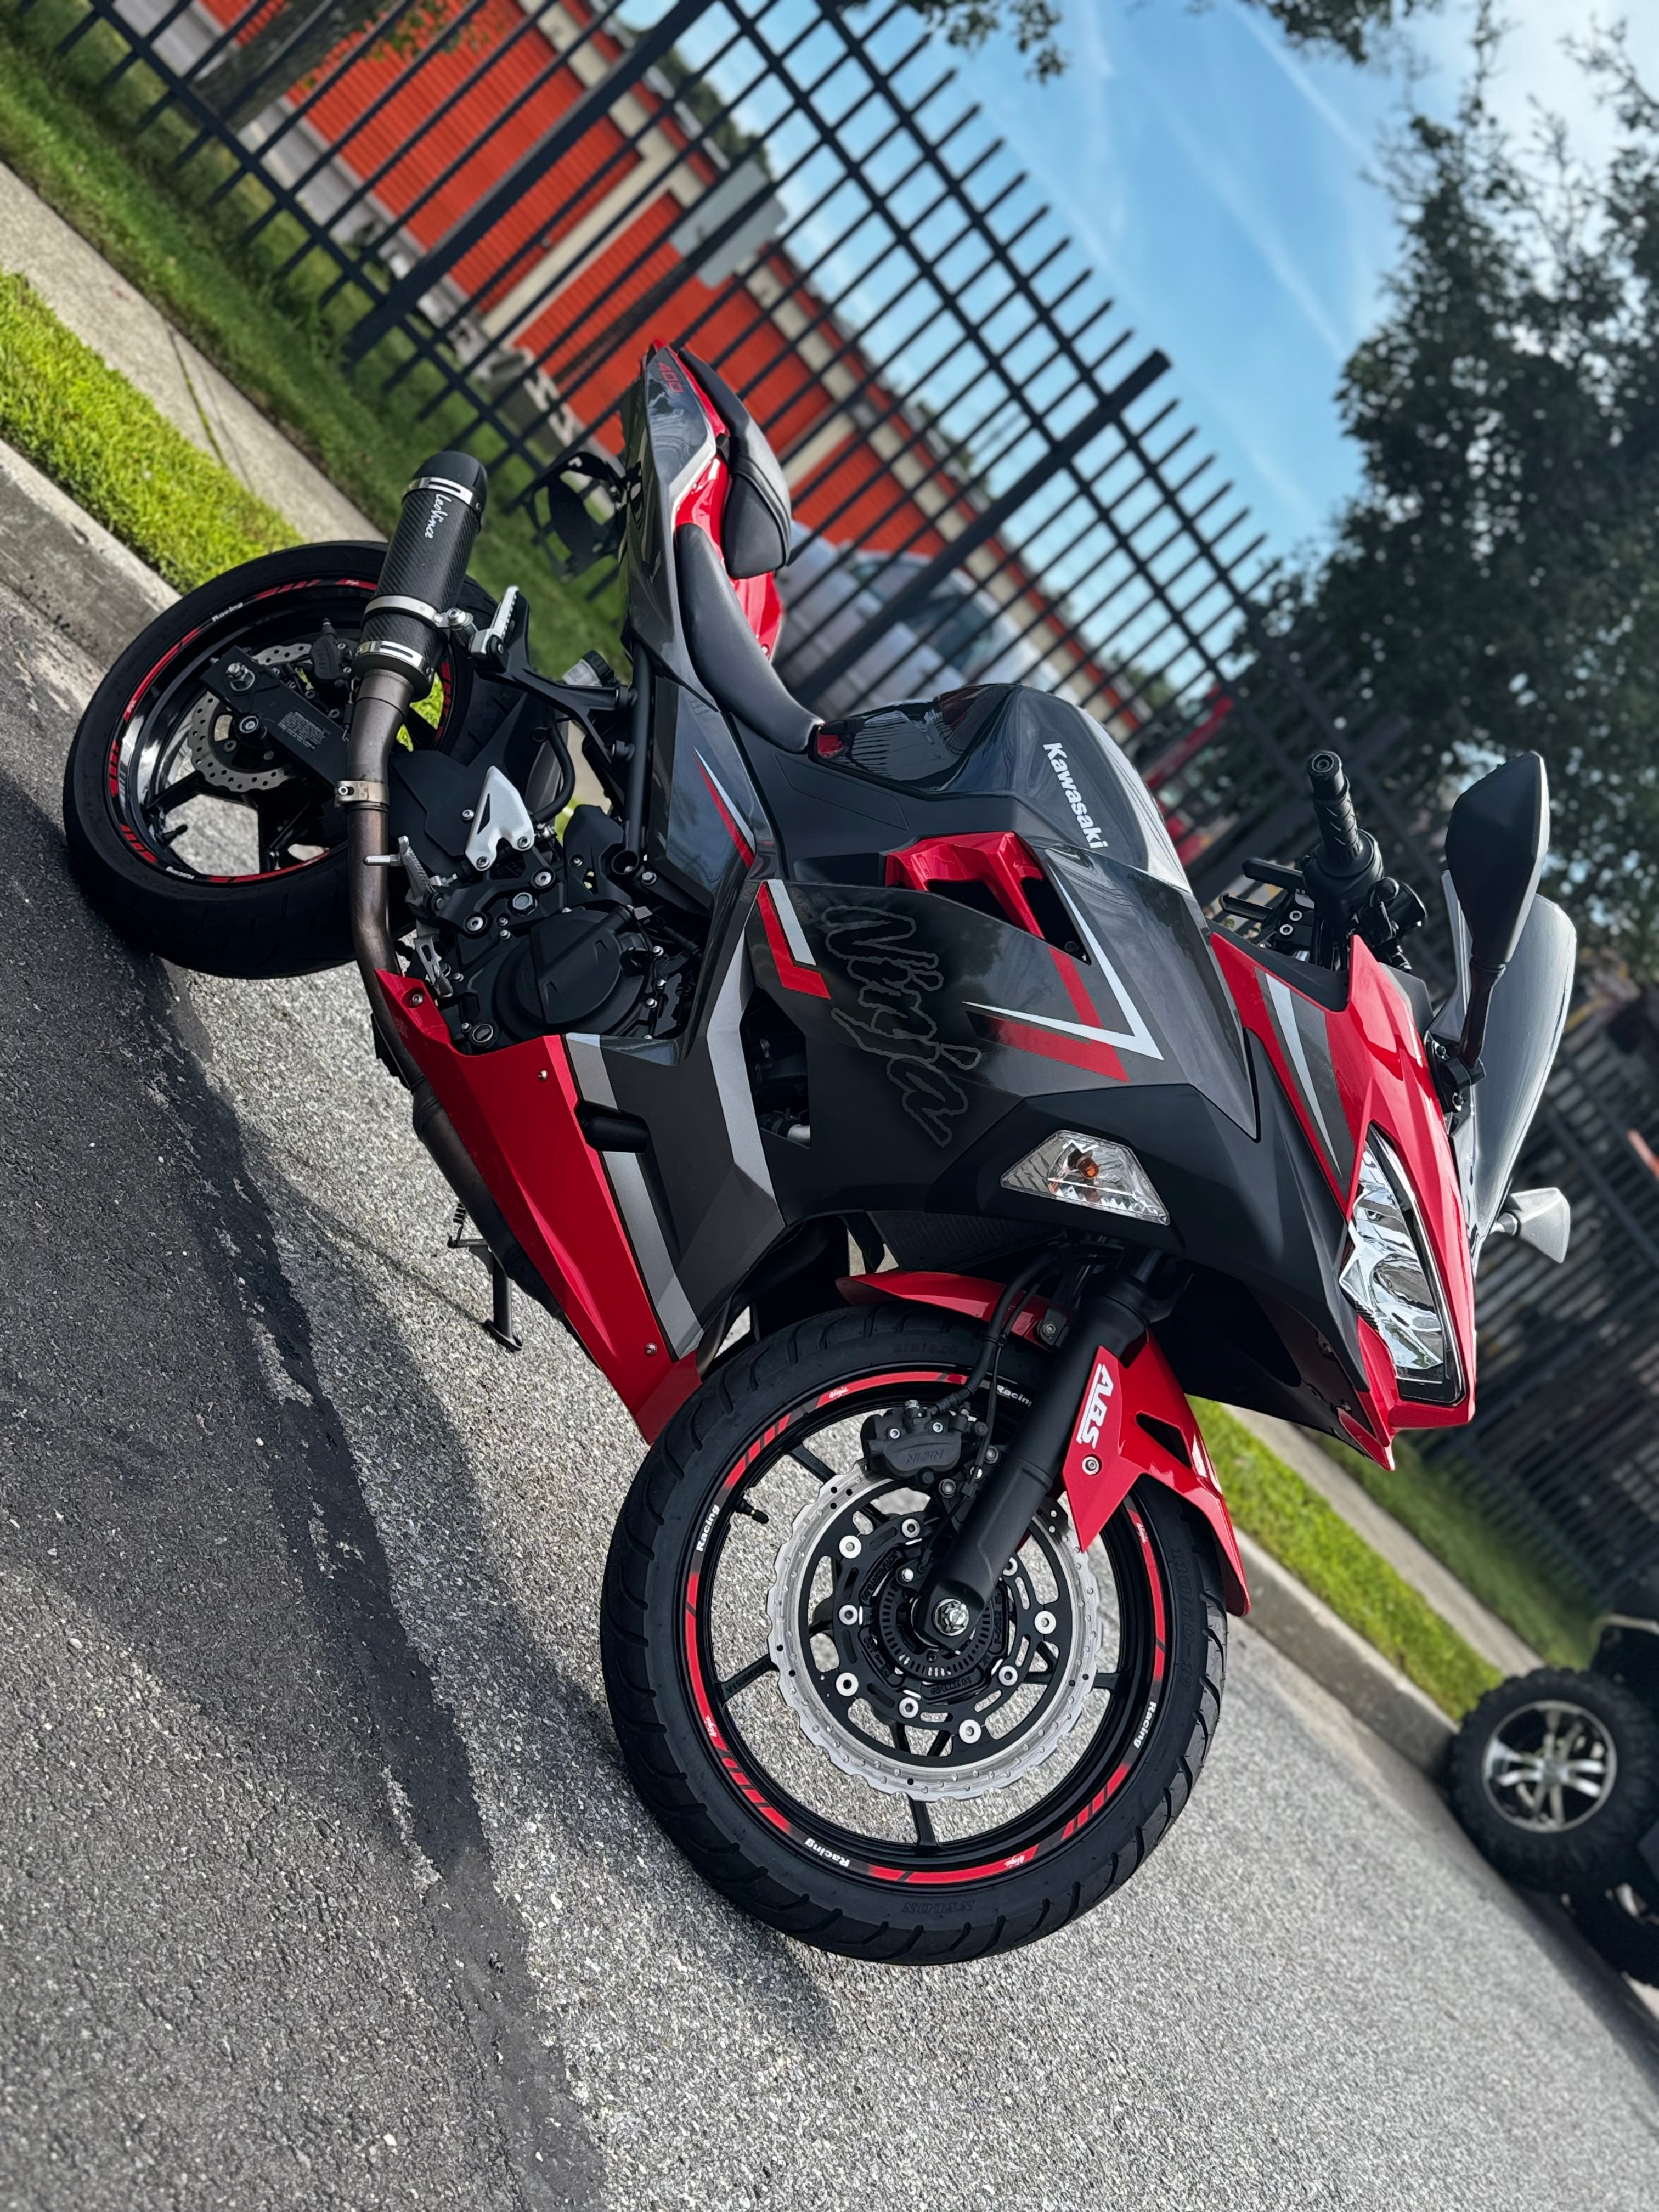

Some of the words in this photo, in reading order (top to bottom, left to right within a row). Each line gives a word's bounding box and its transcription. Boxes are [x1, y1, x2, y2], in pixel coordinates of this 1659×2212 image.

[658, 362, 683, 393] 400
[424, 493, 452, 539] LeoVince
[1043, 742, 1108, 849] Kawasaki
[821, 905, 981, 1148] Ninja
[1077, 1364, 1114, 1450] ABS
[696, 1504, 720, 1553] Racing
[1133, 1702, 1157, 1749] Racing
[805, 1838, 850, 1867] Racing
